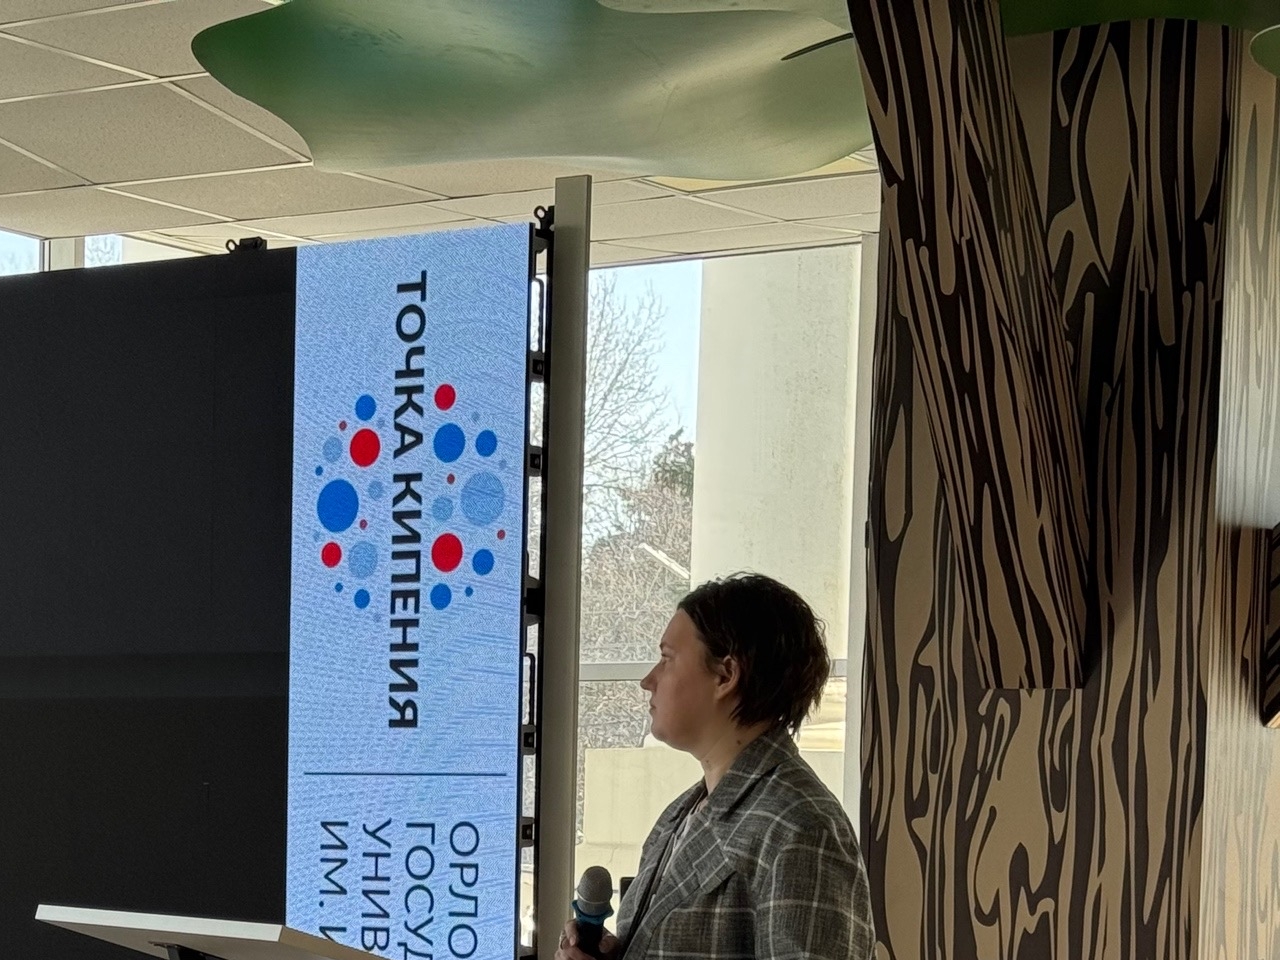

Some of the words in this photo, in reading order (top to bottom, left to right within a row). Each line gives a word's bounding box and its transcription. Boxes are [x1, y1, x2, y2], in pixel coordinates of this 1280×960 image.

[392, 269, 428, 461] ТОЧКА
[388, 471, 424, 729] КИПЕНИЯ
[318, 819, 350, 909] ИМ.
